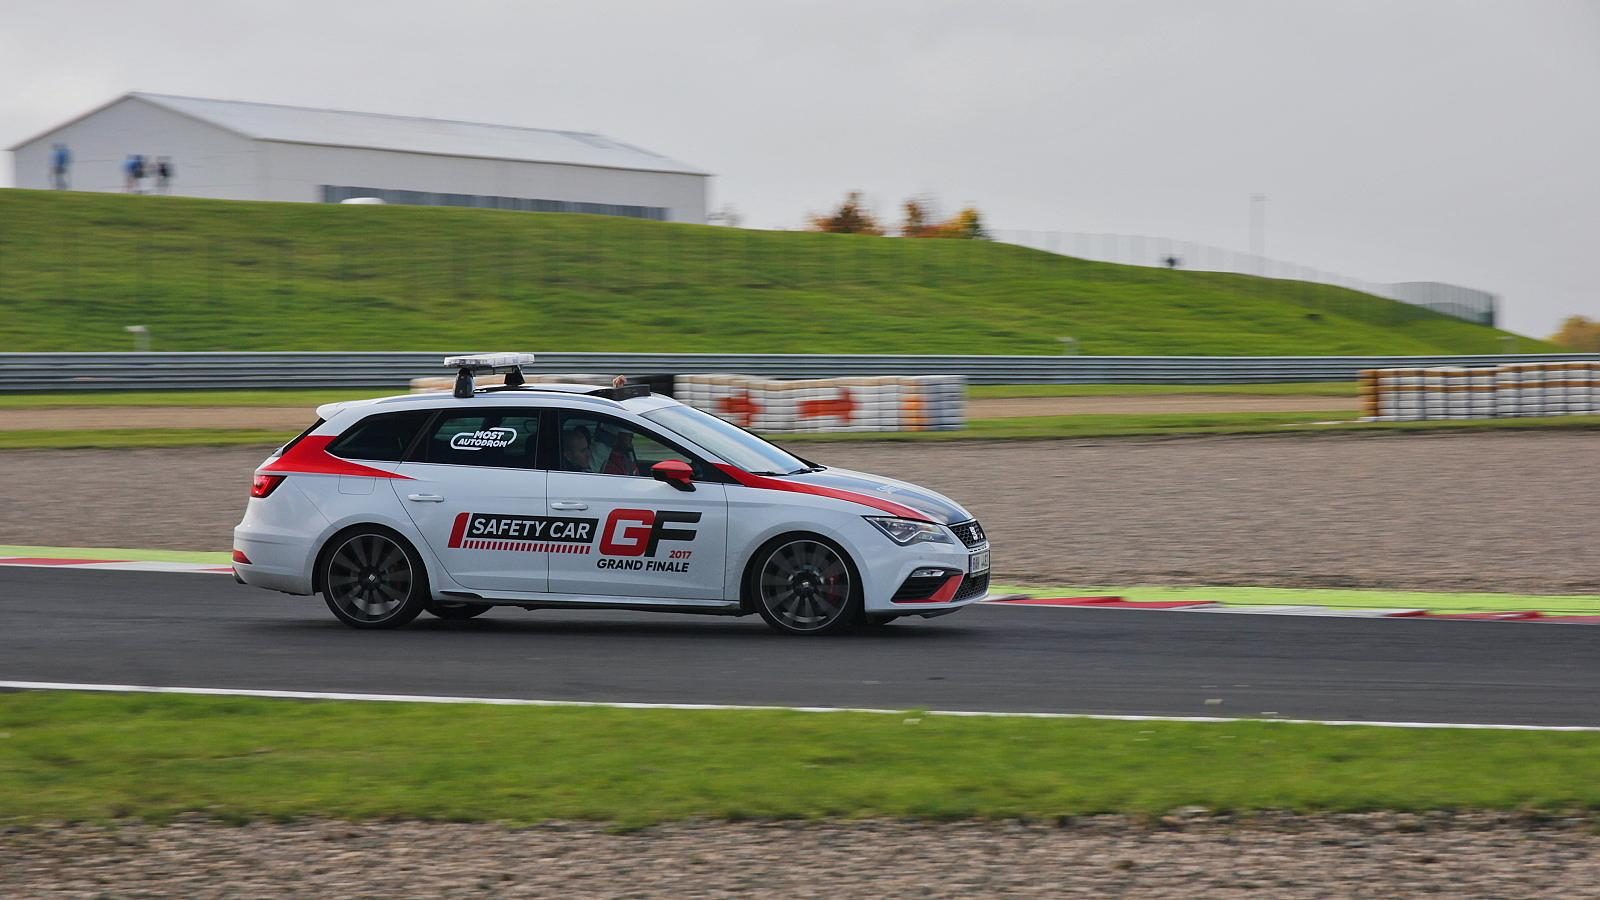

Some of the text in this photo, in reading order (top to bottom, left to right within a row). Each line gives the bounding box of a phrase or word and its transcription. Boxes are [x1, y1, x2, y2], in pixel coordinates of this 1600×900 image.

[473, 430, 505, 440] MOST
[457, 438, 508, 448] AUTODROM
[472, 518, 590, 539] SAFETY CAR
[599, 508, 702, 557] GF
[669, 550, 692, 560] 2017
[597, 558, 690, 573] GRAND FINALE
